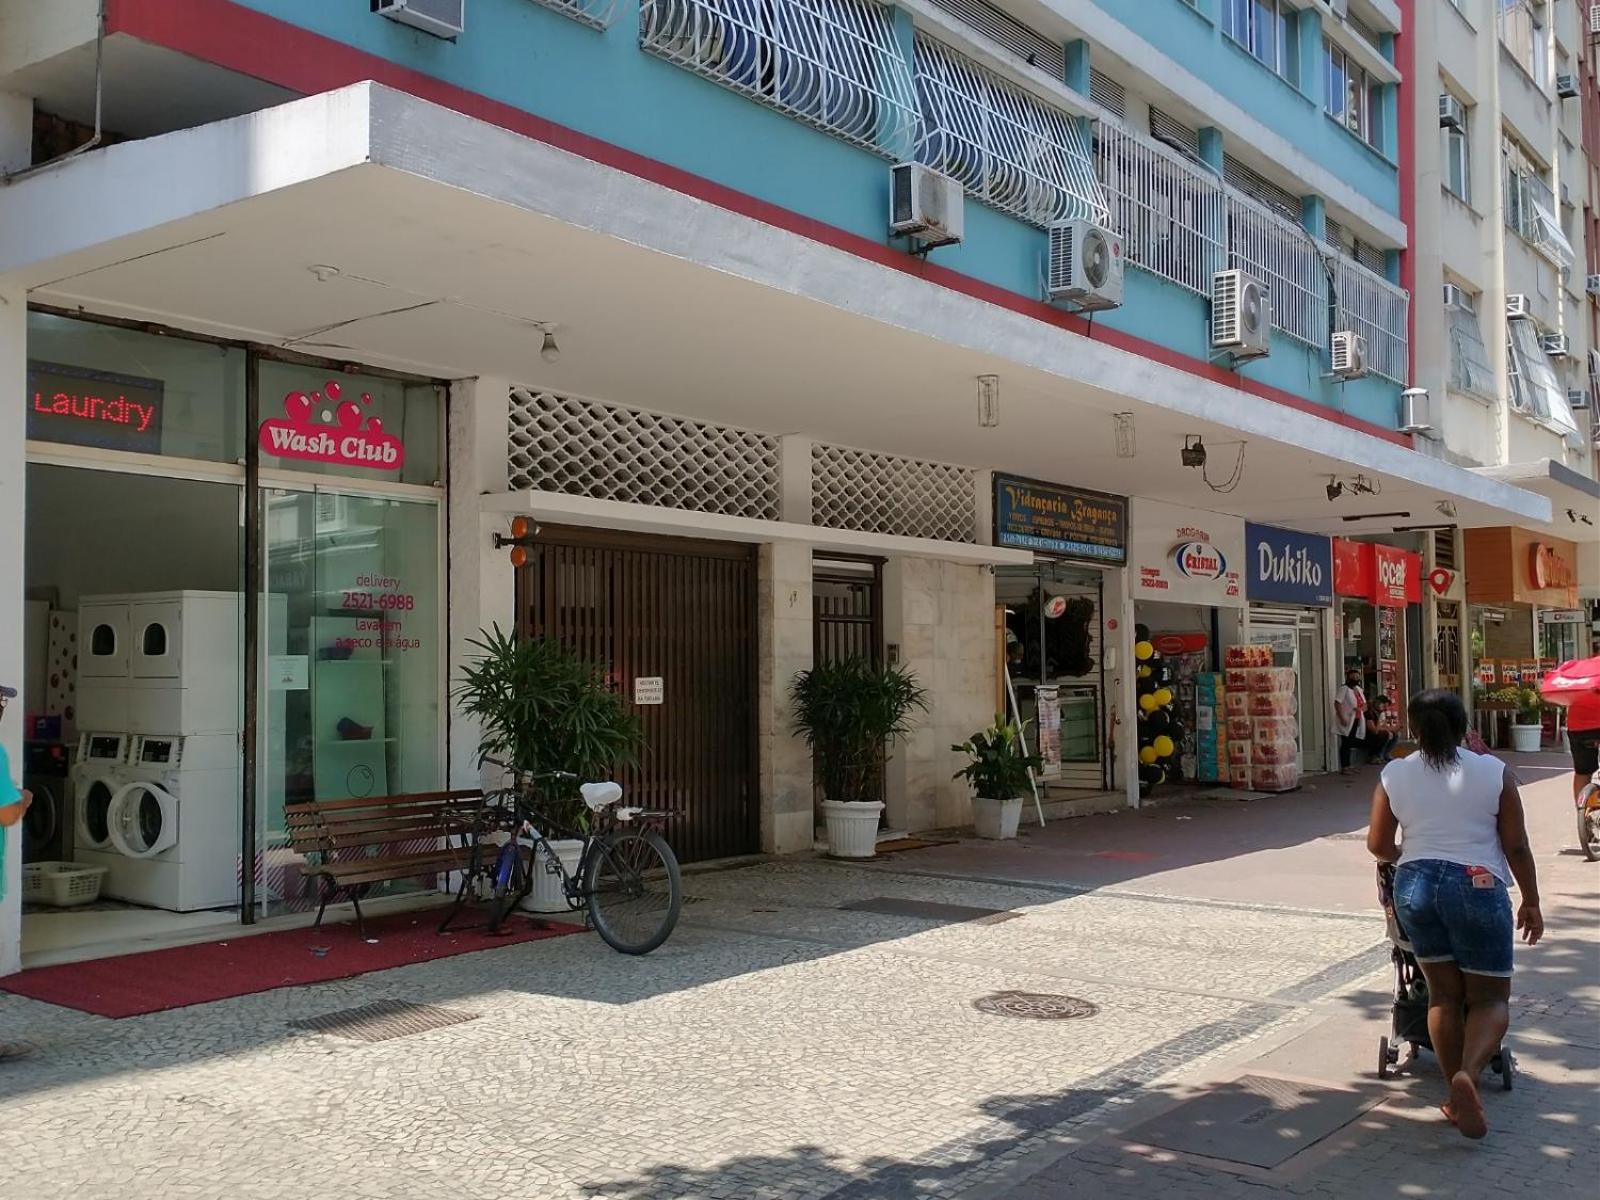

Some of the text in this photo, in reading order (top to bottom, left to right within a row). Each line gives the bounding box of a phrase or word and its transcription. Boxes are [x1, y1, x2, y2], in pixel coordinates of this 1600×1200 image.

[34, 392, 155, 432] Laundry
[269, 426, 397, 463] Wash Club
[356, 572, 401, 590] delivery
[1257, 541, 1322, 587] Dukiko
[342, 591, 415, 610] 2521-6988
